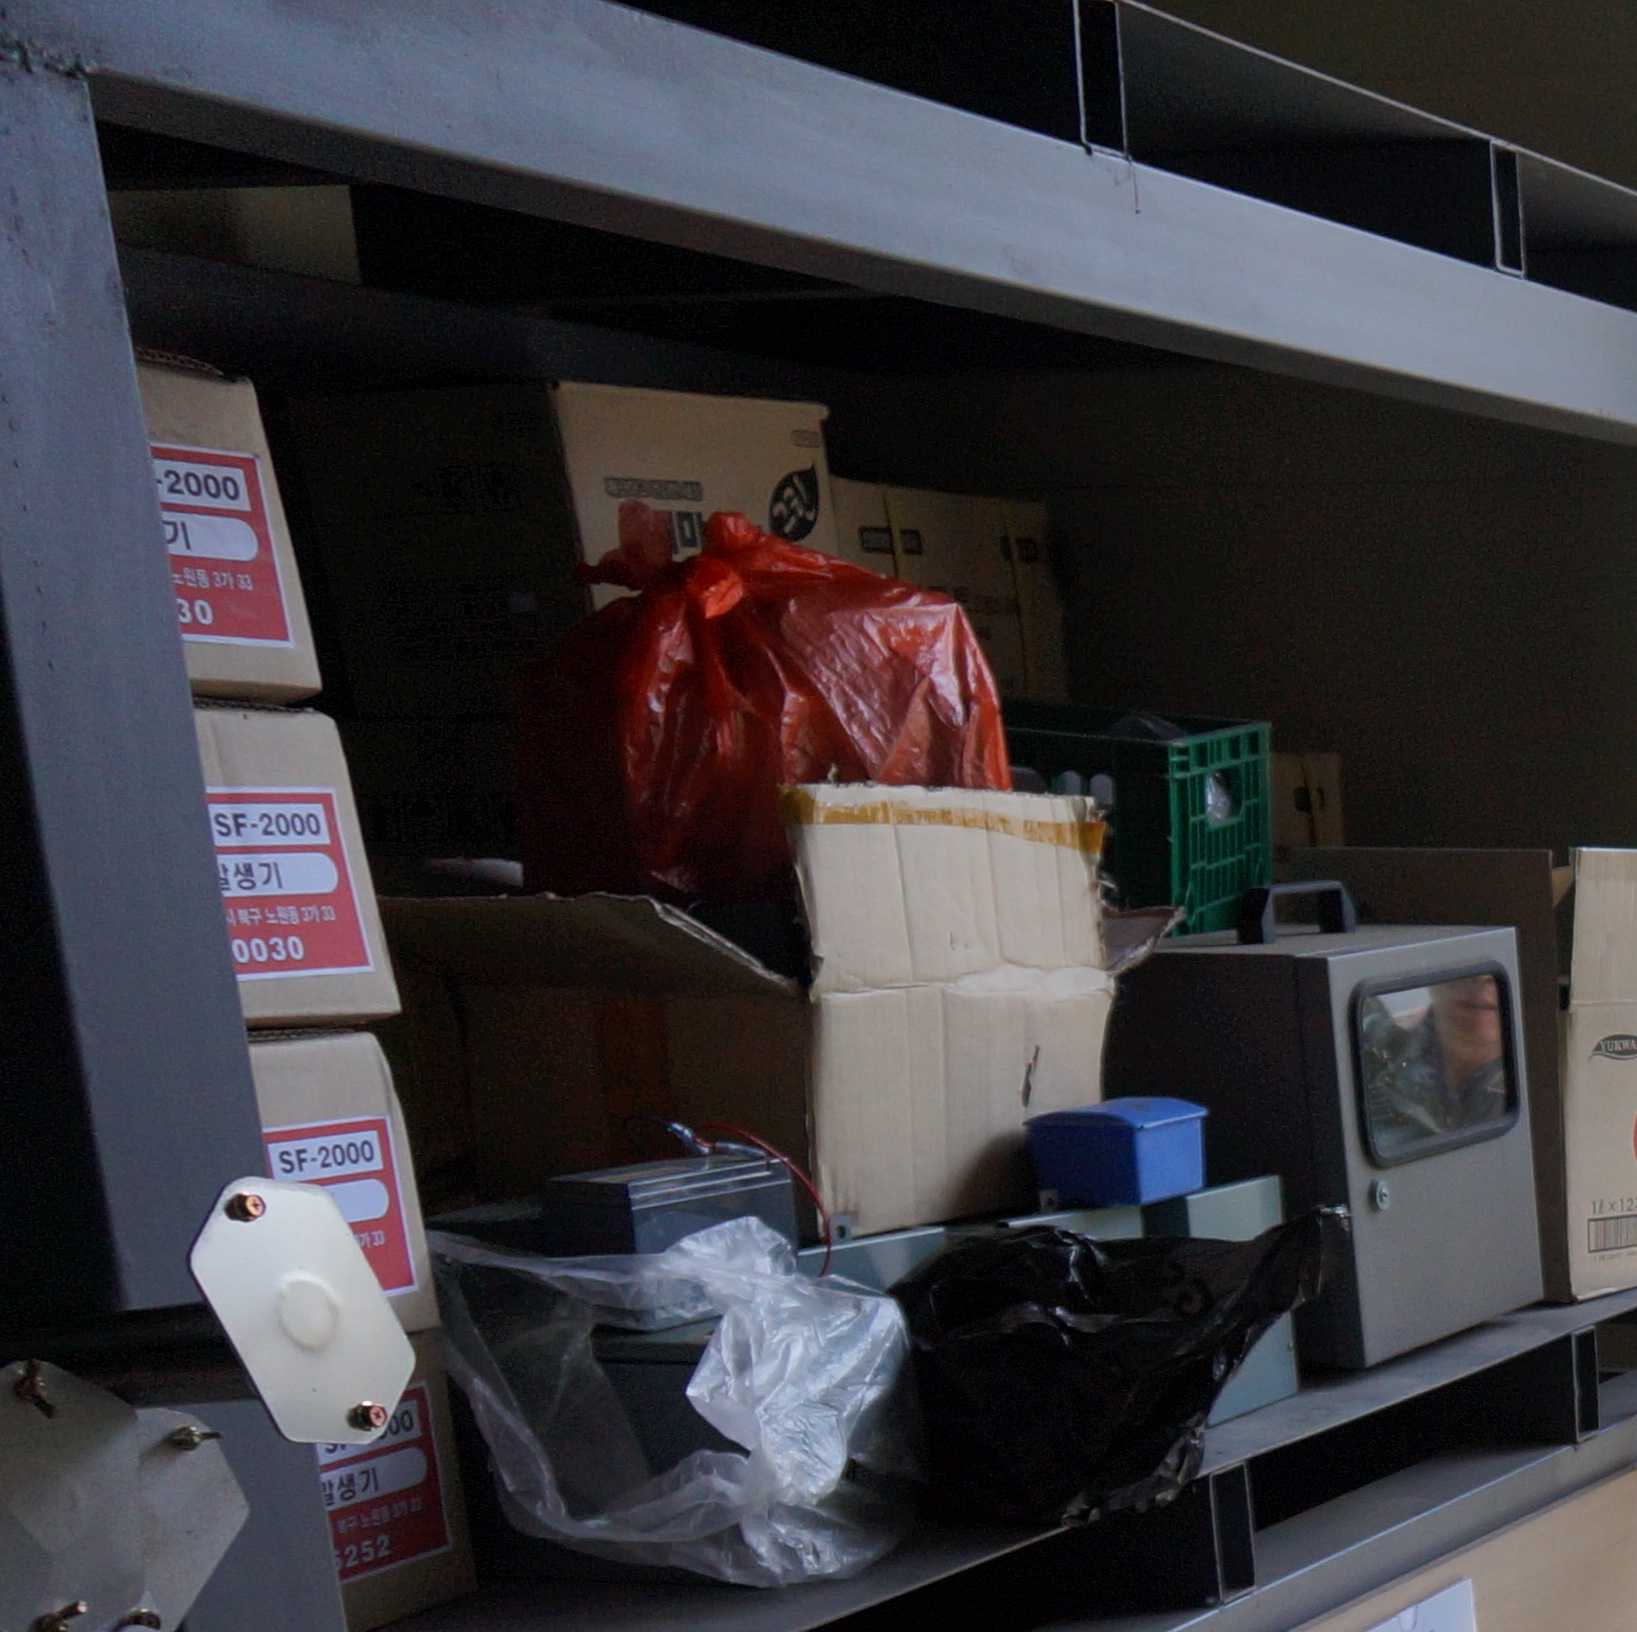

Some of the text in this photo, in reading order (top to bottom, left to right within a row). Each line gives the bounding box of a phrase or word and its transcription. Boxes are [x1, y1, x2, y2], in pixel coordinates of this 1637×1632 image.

[214, 812, 321, 837] SF-2000
[231, 935, 305, 963] 0030
[277, 1139, 375, 1175] SF-2000
